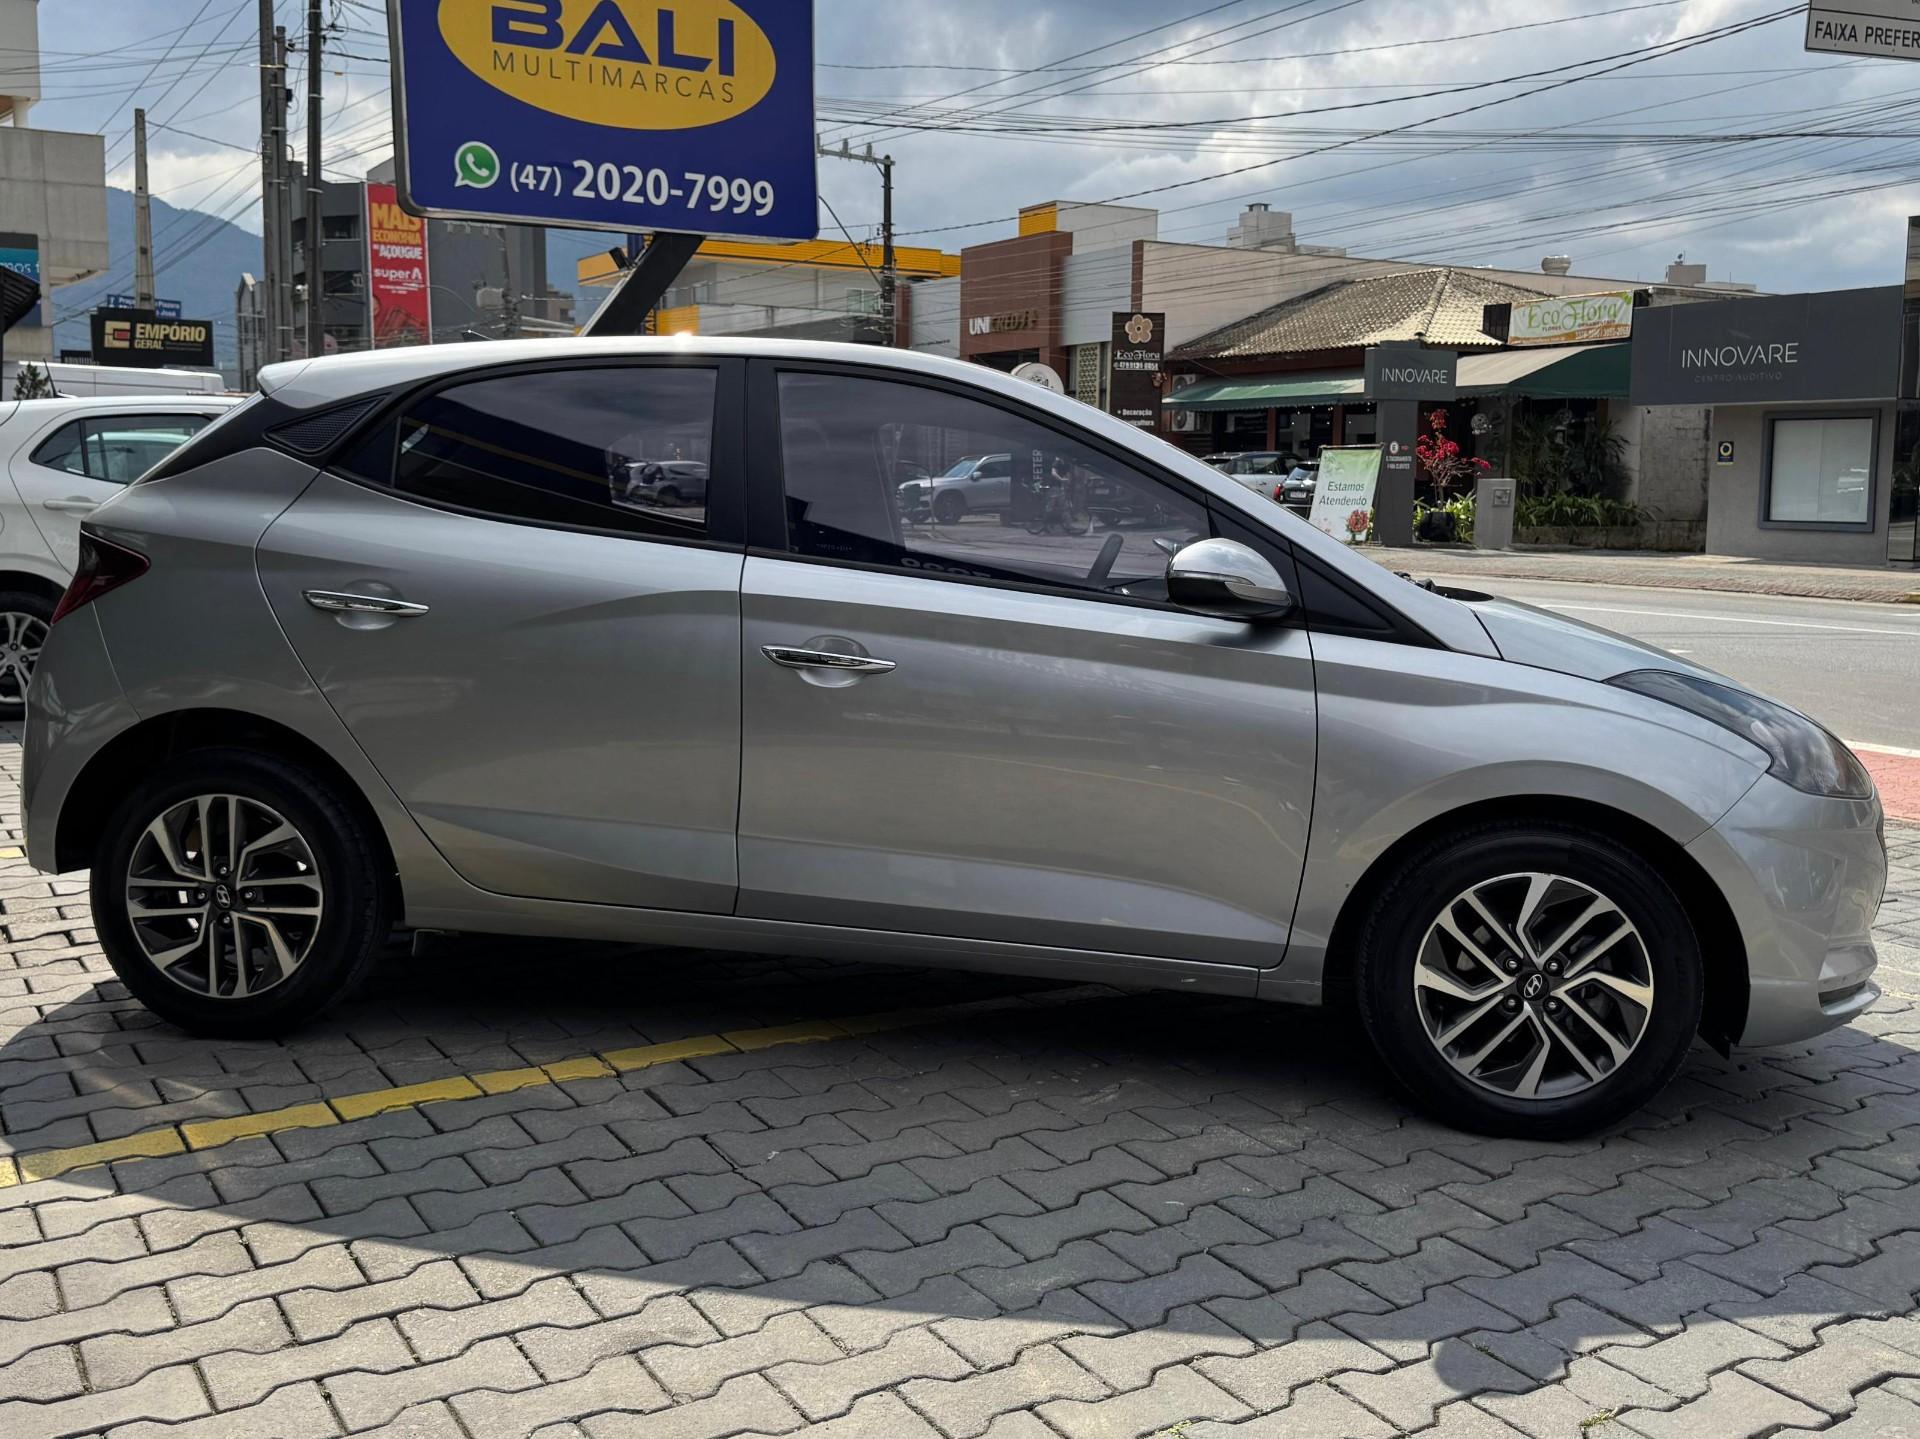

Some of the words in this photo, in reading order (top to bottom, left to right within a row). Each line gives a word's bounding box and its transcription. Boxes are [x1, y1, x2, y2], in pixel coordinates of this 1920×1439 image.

[492, 0, 735, 77] BALI
[1815, 20, 1858, 42] FAIXA
[493, 49, 735, 104] MULTIMARCAS
[510, 162, 562, 197] (47)
[572, 159, 775, 216] 2020-7999
[372, 229, 422, 245] ECONOMIA
[135, 322, 206, 342] EMPÓRIO
[134, 339, 164, 350] GERAL
[1682, 342, 1799, 368] INNOVARE
[1381, 367, 1448, 384] INNOVARE
[1327, 481, 1365, 491] Estamos
[1319, 495, 1367, 506] Atendendo
